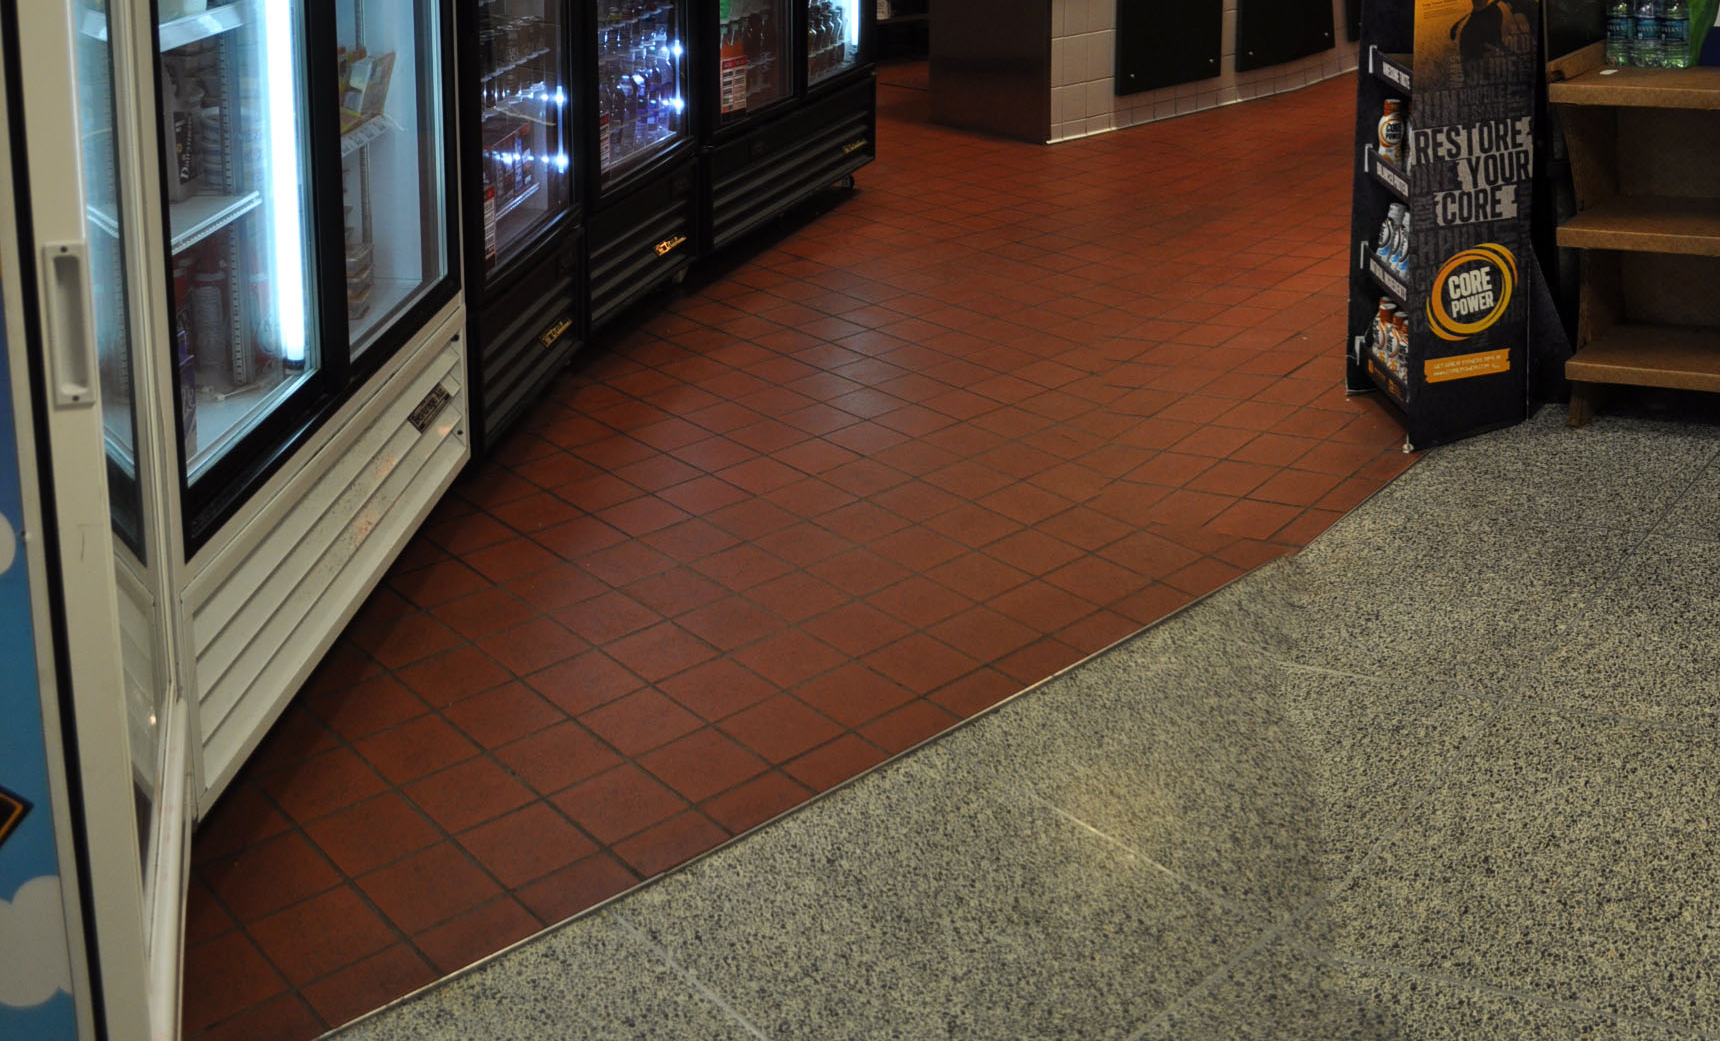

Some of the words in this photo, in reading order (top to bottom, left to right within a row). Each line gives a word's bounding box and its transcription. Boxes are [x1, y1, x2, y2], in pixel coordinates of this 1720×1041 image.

[1414, 118, 1524, 165] RESTORE
[1466, 149, 1531, 189] YOUR
[1441, 186, 1503, 224] CORE
[1448, 266, 1493, 299] CORE
[1451, 291, 1495, 318] POWER
